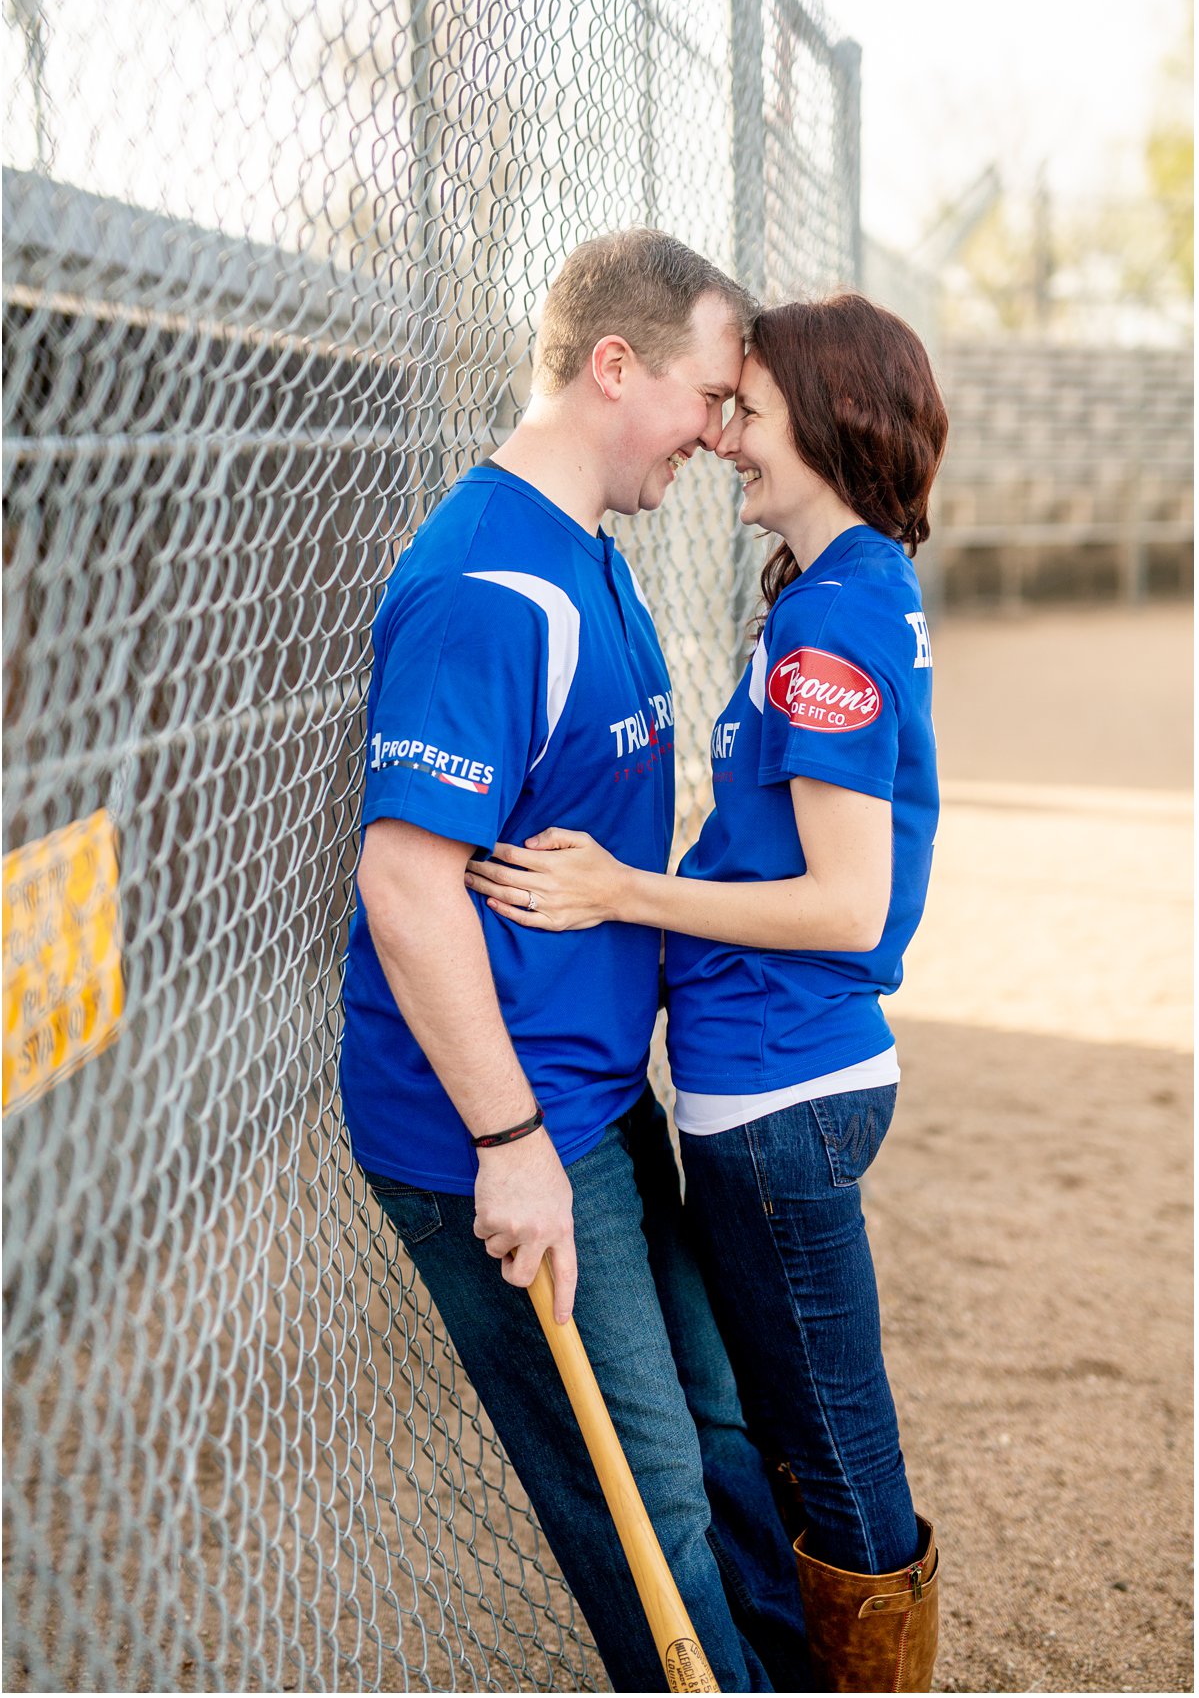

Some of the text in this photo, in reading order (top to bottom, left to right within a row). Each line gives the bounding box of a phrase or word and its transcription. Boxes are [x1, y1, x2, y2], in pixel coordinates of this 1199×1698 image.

[904, 612, 933, 669] H
[807, 707, 827, 721] FIT
[380, 739, 495, 785] PROPERTIES
[674, 1642, 696, 1681] HILLERICH
[688, 1681, 698, 1689] &
